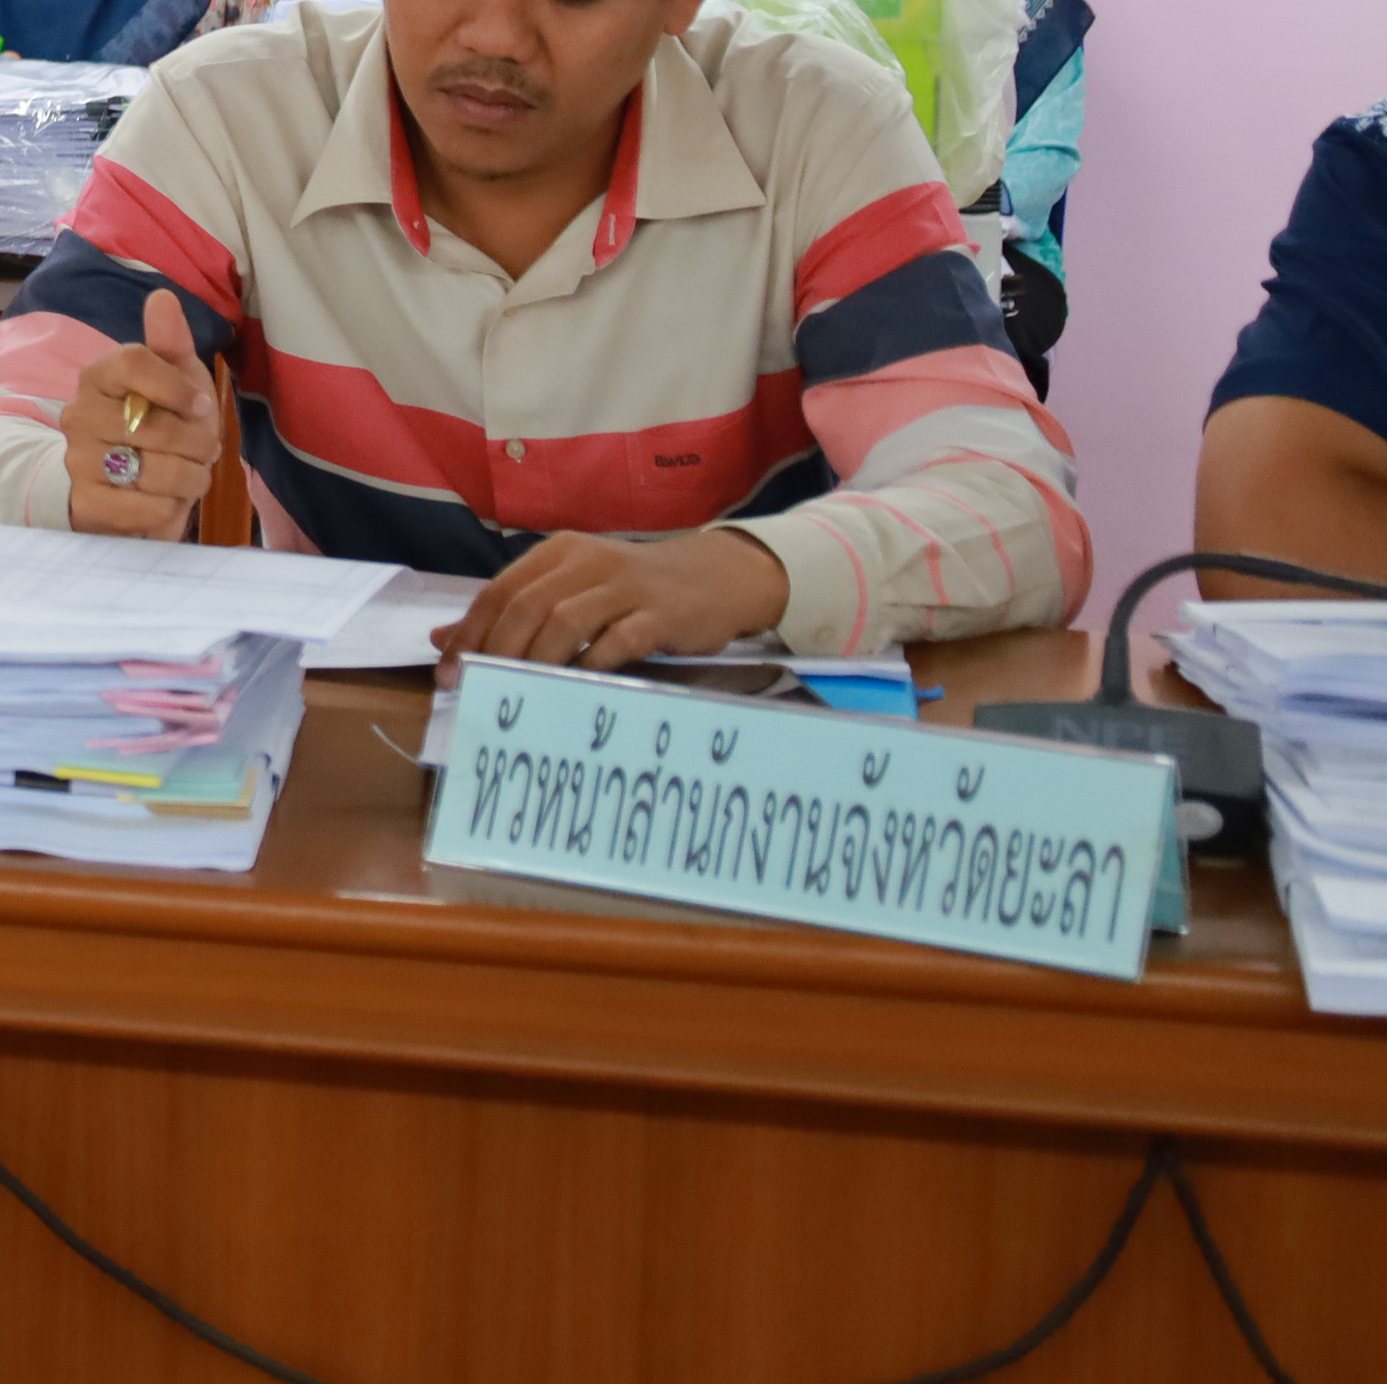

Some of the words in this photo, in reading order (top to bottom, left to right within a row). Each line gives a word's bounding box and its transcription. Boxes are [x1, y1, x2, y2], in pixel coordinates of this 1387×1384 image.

[468, 695, 1127, 945] หัวหน้าสำนักงานจังหวัดยะลา
